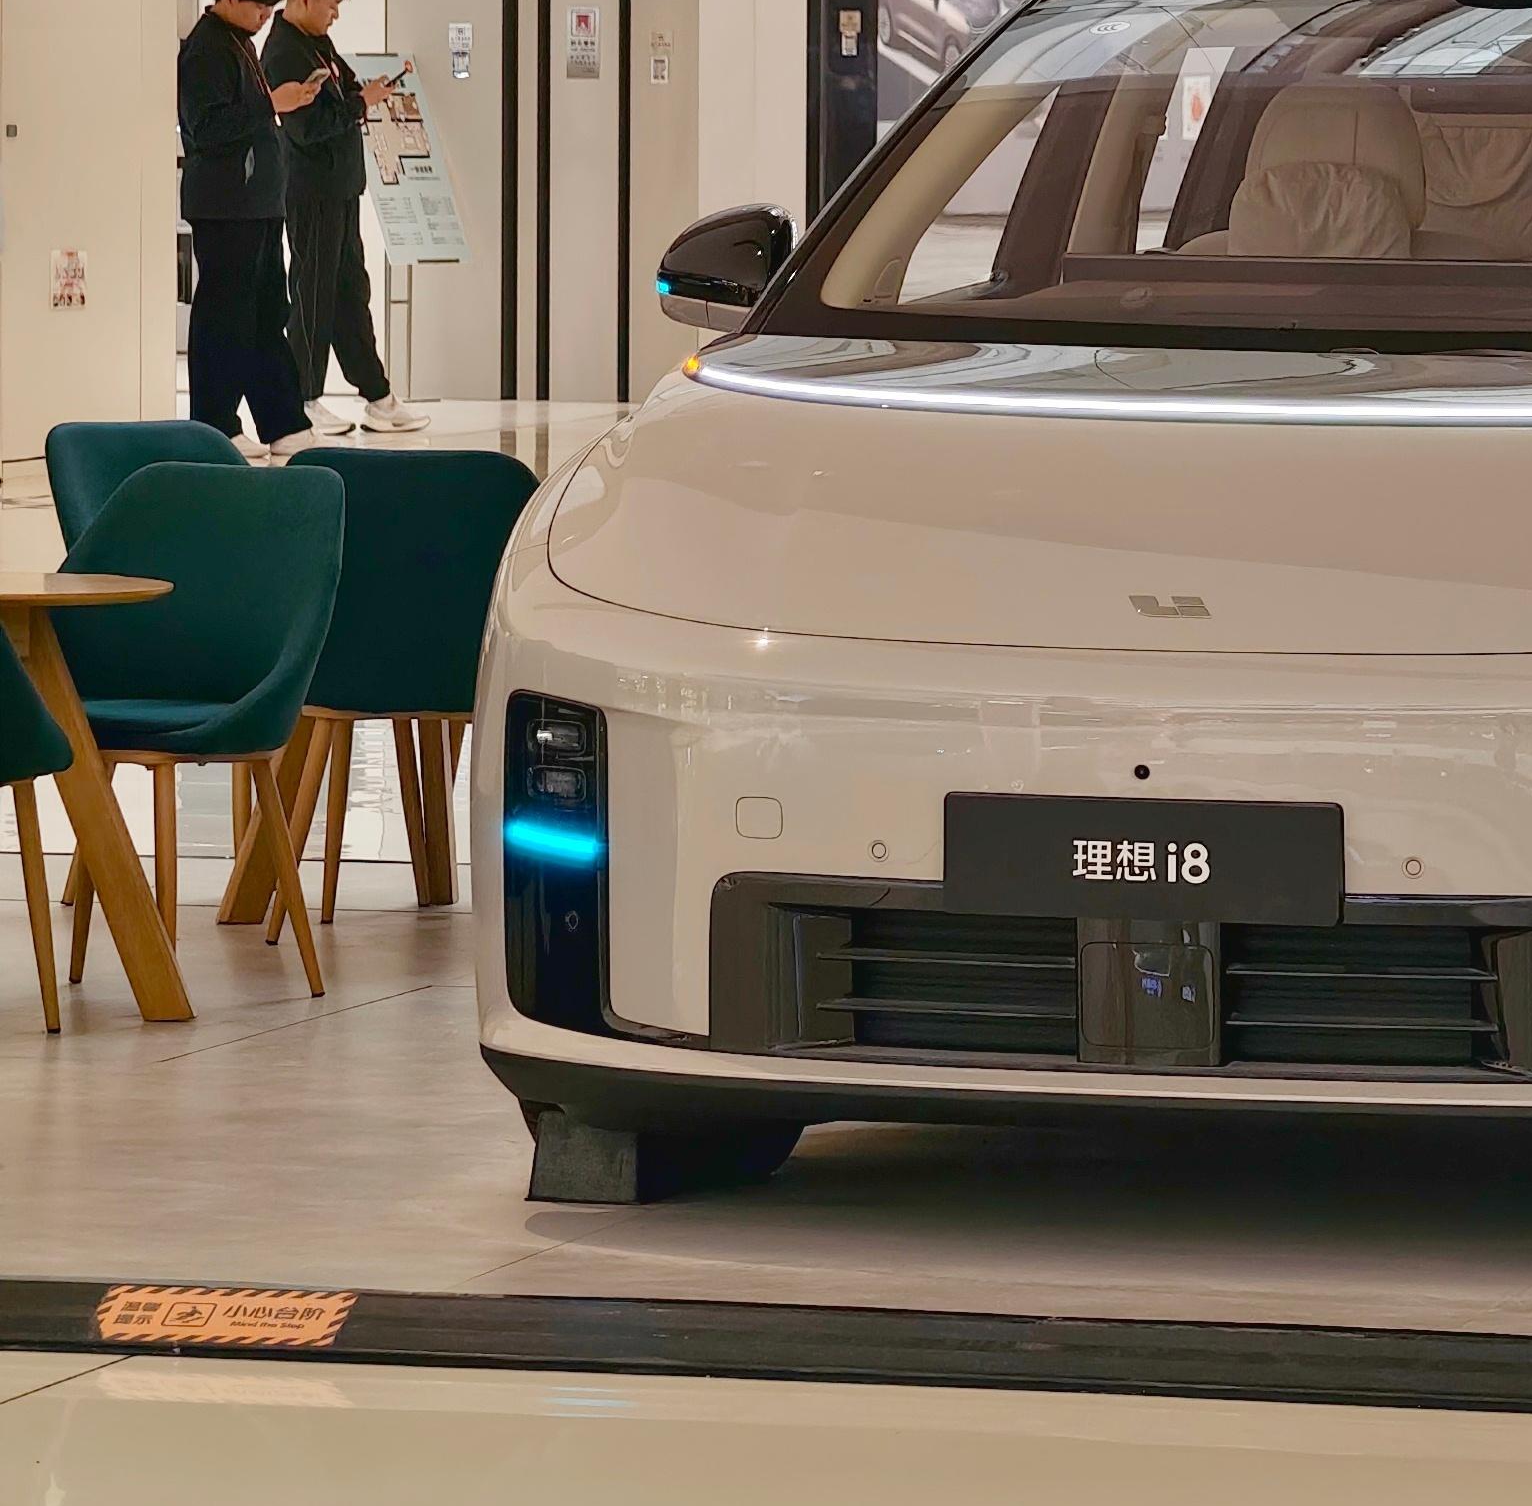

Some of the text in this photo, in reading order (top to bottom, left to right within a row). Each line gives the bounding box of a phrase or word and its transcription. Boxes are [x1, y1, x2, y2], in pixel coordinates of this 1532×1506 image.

[1072, 839, 1211, 884] 理想 i8
[121, 1301, 163, 1313] 温馨
[222, 1303, 327, 1322] 小心台阶
[113, 1313, 155, 1326] 提示
